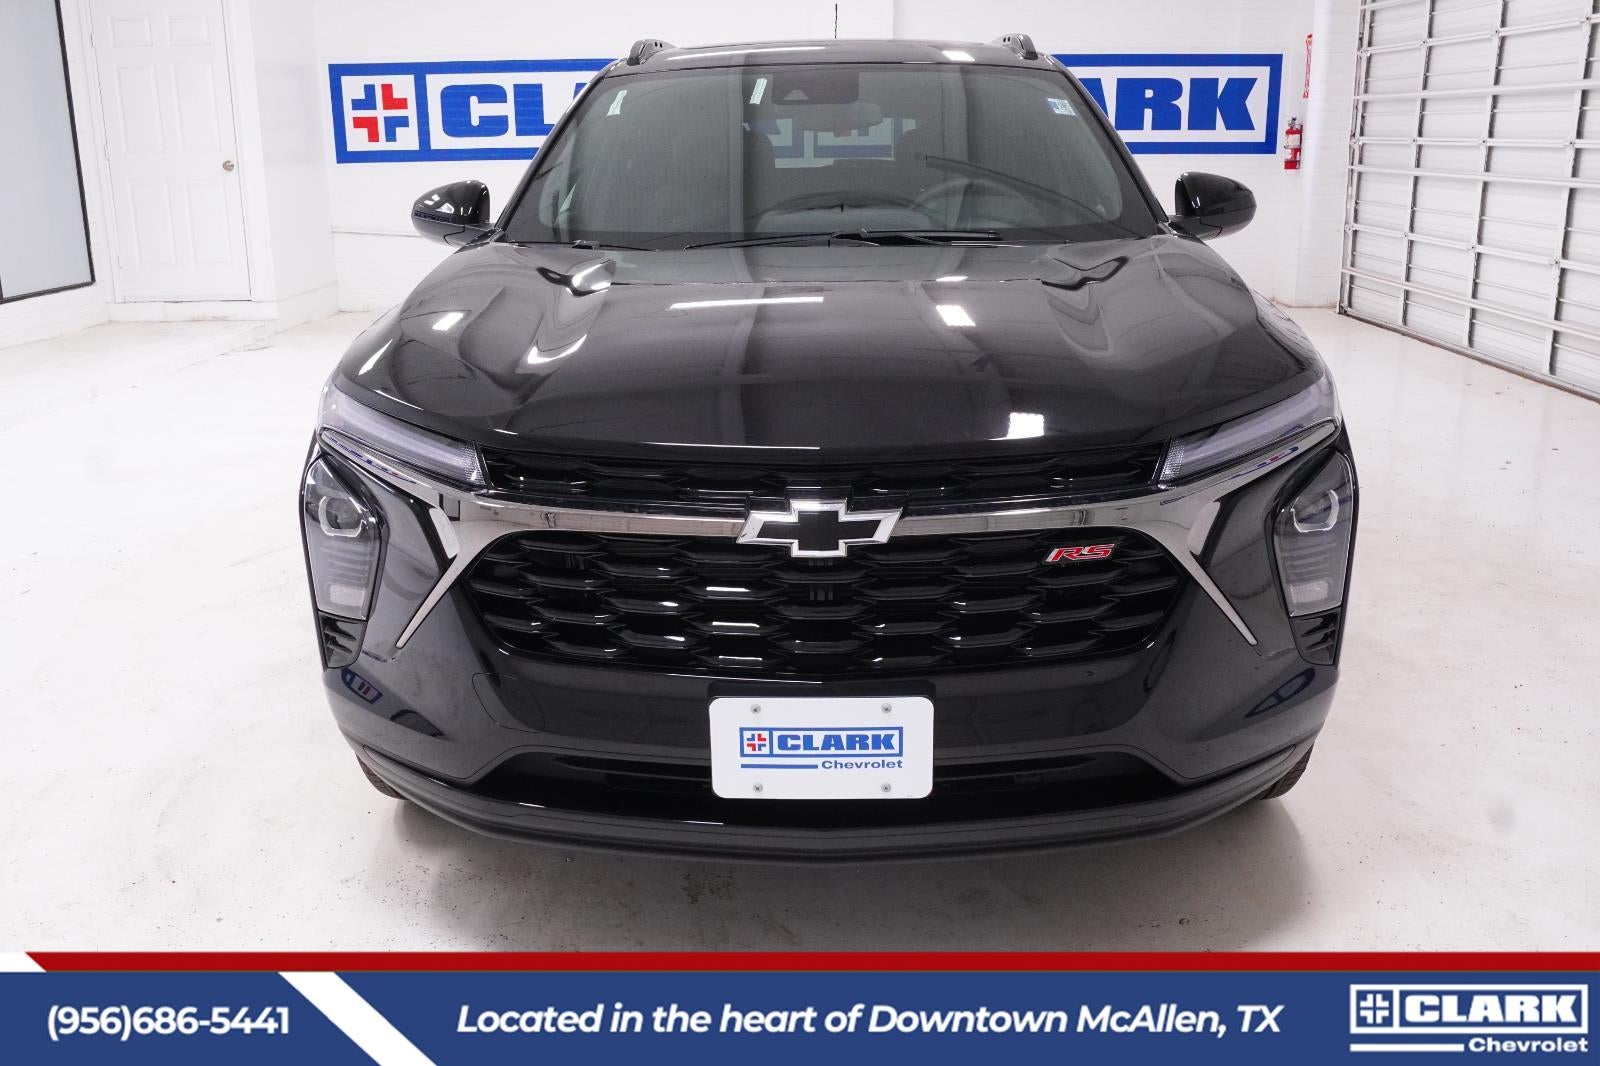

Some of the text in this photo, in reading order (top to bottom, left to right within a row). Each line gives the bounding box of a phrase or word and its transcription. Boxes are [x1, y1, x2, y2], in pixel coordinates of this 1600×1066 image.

[440, 82, 587, 139] CL
[1045, 543, 1115, 562] RS
[777, 734, 896, 751] CLARK
[821, 759, 903, 769] Chevrolet
